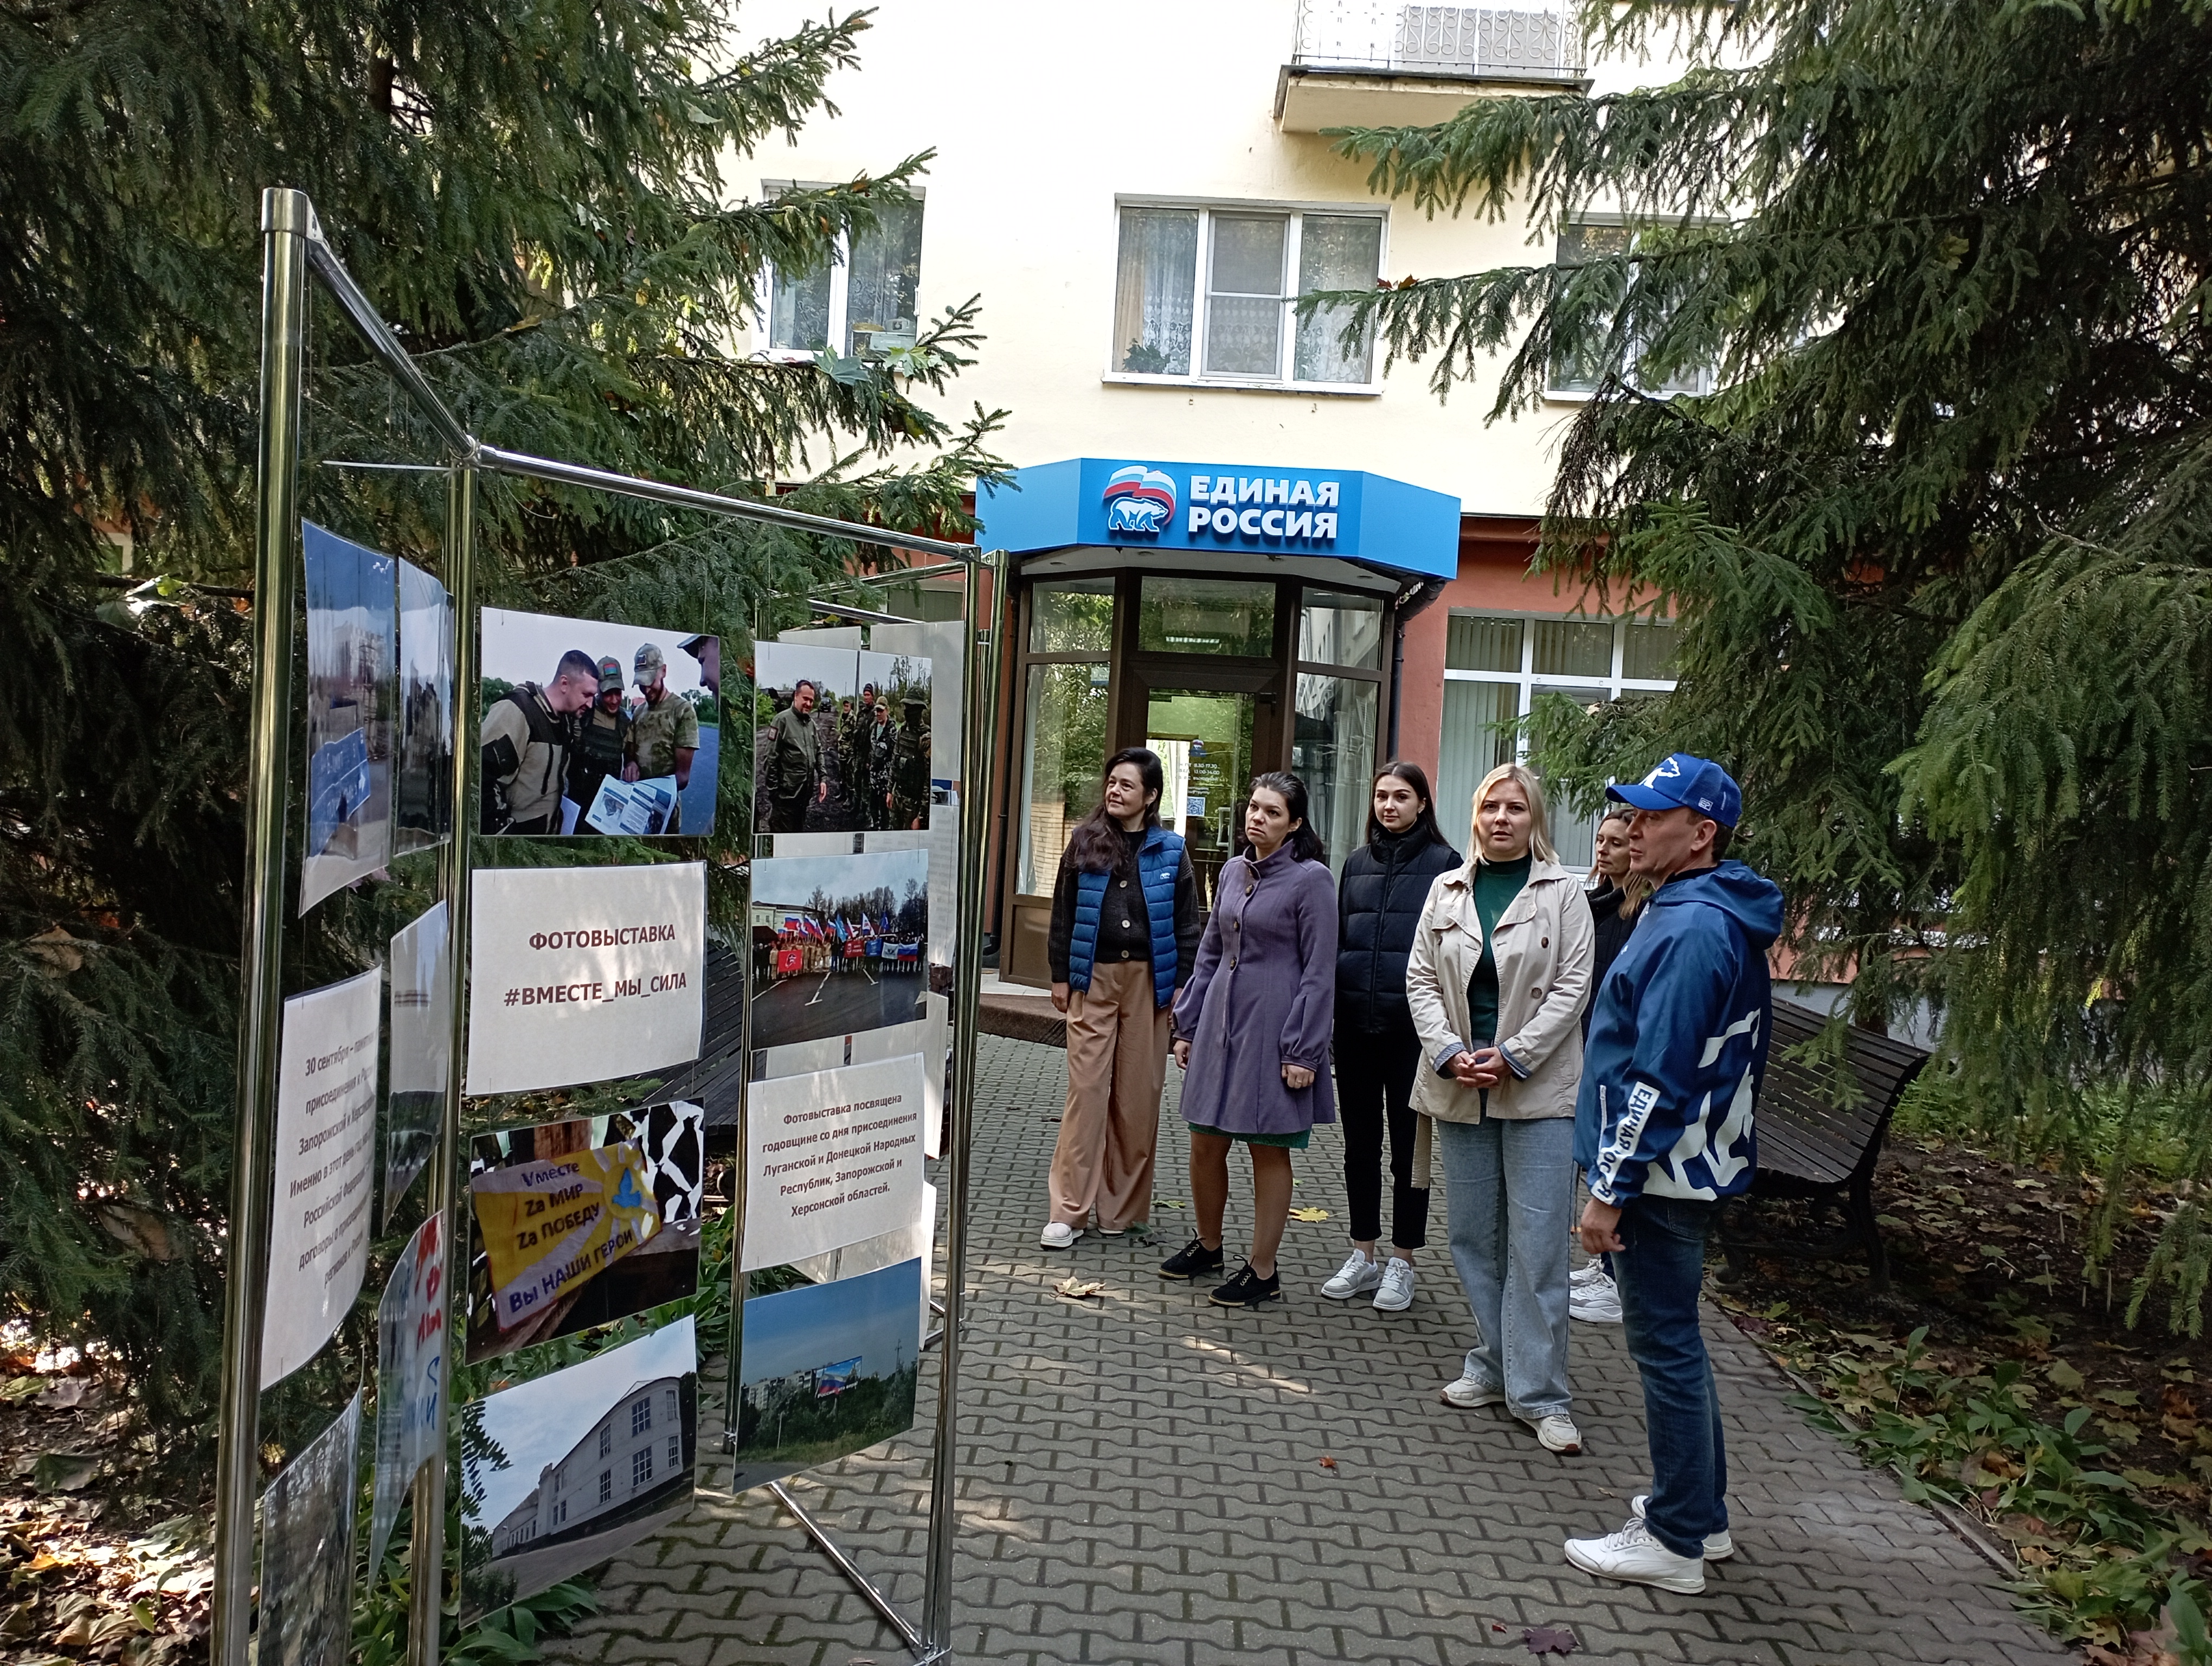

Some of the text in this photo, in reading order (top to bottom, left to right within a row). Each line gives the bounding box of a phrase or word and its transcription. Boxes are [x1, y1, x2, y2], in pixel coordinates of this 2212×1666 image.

[1190, 476, 1339, 507] ЕДИНАЯ
[1188, 506, 1338, 539] РОССИЯ
[529, 924, 676, 950] ФОТОВЫСТАВКА
[504, 972, 687, 1007] #ВМЕСТЕ_МЫ_СИЛА
[305, 1057, 316, 1077] 30
[318, 1046, 349, 1072] сентября
[783, 1093, 902, 1125] Фотовыставка посвящена
[1619, 1088, 1653, 1151] ЕДИНАЯ
[299, 1113, 346, 1156] Запорожской
[762, 1112, 917, 1153] годовщине со дня присоединения
[763, 1133, 916, 1177] Луганской и Донецкой Народных
[290, 1169, 321, 1199] Именно
[323, 1166, 327, 1179] в
[329, 1156, 342, 1175] этот
[780, 1158, 902, 1196] Республик, Запорожской и
[1597, 1150, 1620, 1199] ОСЯ
[304, 1186, 342, 1228] Российской
[549, 1183, 584, 1208] МИР
[791, 1181, 890, 1218] Херсонской областей.
[542, 1202, 600, 1240] ПОБЕДУ
[299, 1231, 333, 1272] договоры
[509, 1228, 634, 1313] Вы НАШИ ГЕРОИ
